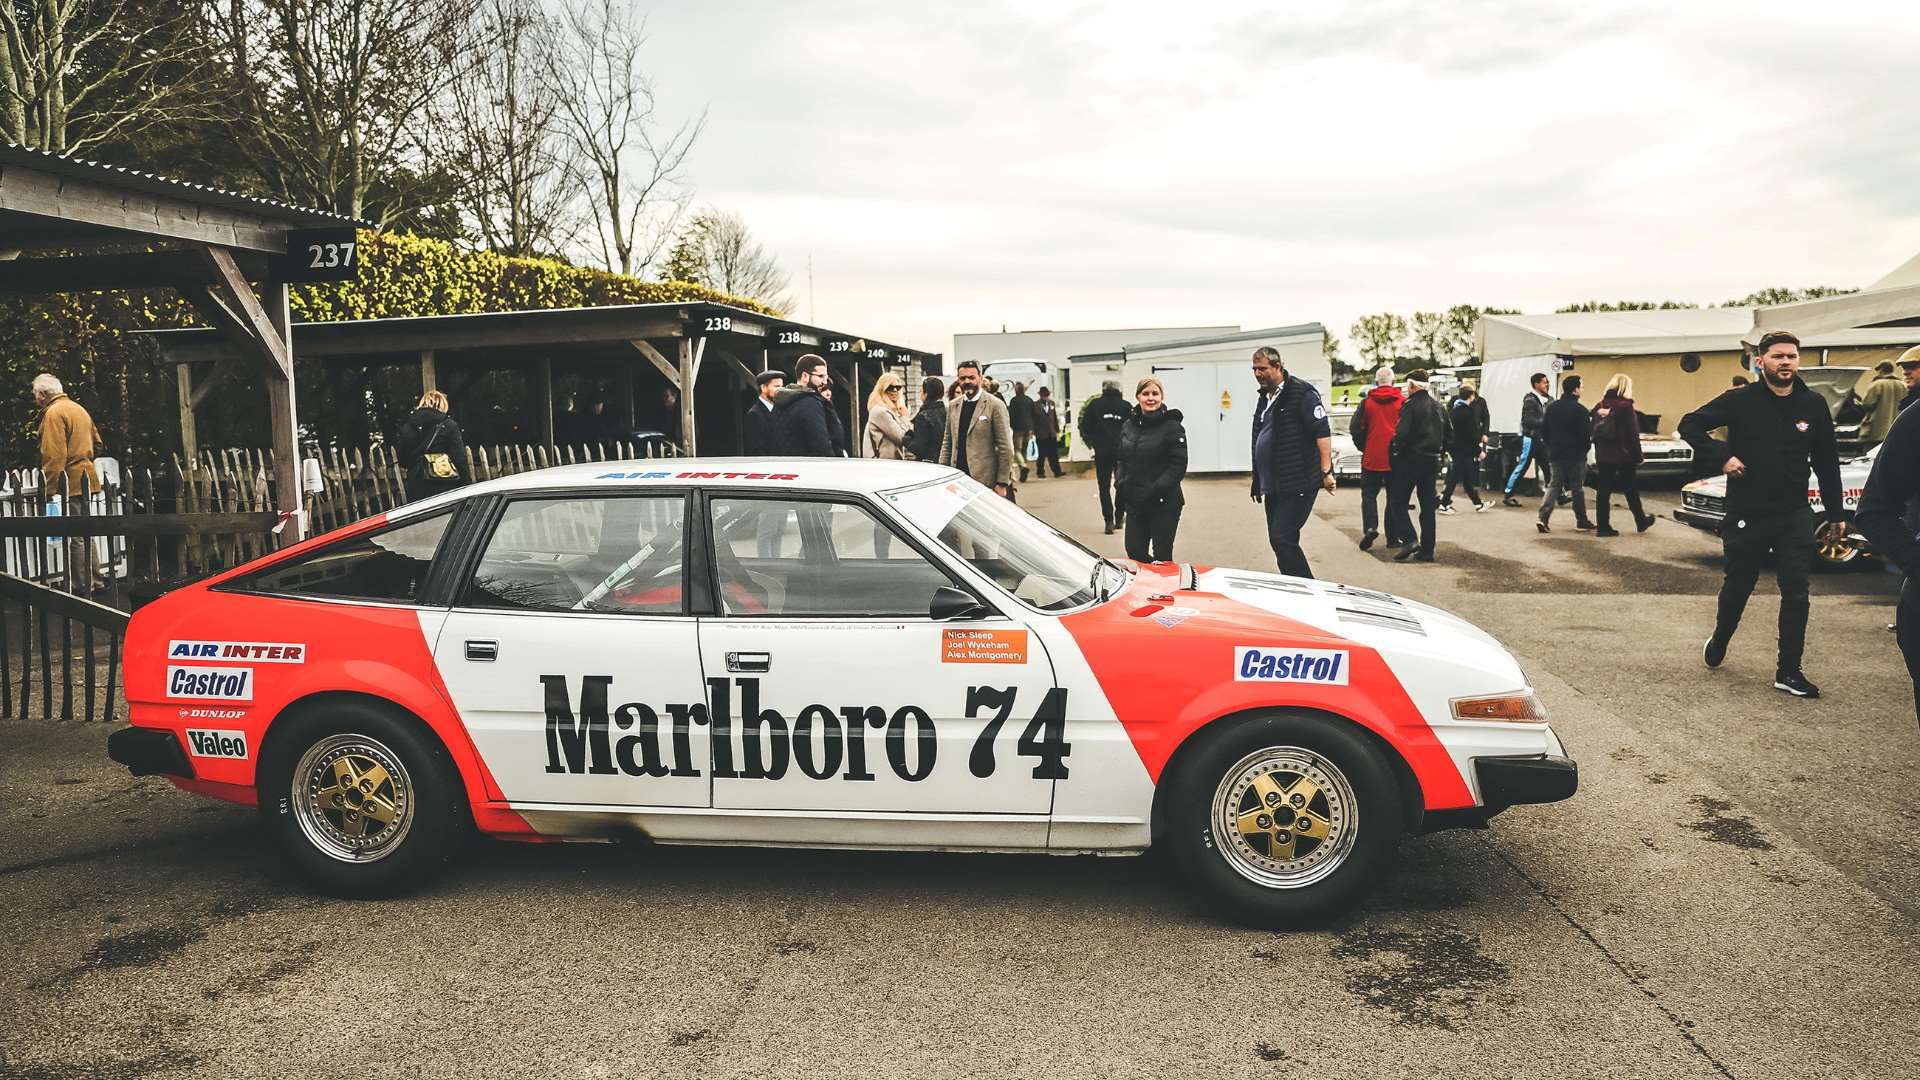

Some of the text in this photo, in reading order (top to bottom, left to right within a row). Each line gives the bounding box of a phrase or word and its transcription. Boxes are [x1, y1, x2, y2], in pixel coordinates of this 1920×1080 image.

[309, 242, 355, 268] 237
[705, 317, 731, 331] 238
[779, 332, 800, 344] 238
[830, 341, 849, 352] 239
[867, 349, 885, 358] 240
[675, 472, 800, 480] INTER
[947, 631, 967, 639] Nick
[172, 643, 302, 660] AIR INTER
[947, 641, 1010, 650] Joel Wykeham
[947, 651, 1022, 661] Alex Montgomery
[1240, 649, 1343, 681] Castrol
[170, 668, 248, 697] Castrol
[191, 709, 246, 719] DUNLOP
[539, 674, 1073, 782] Marlboro 74
[188, 731, 246, 757] Valeo
